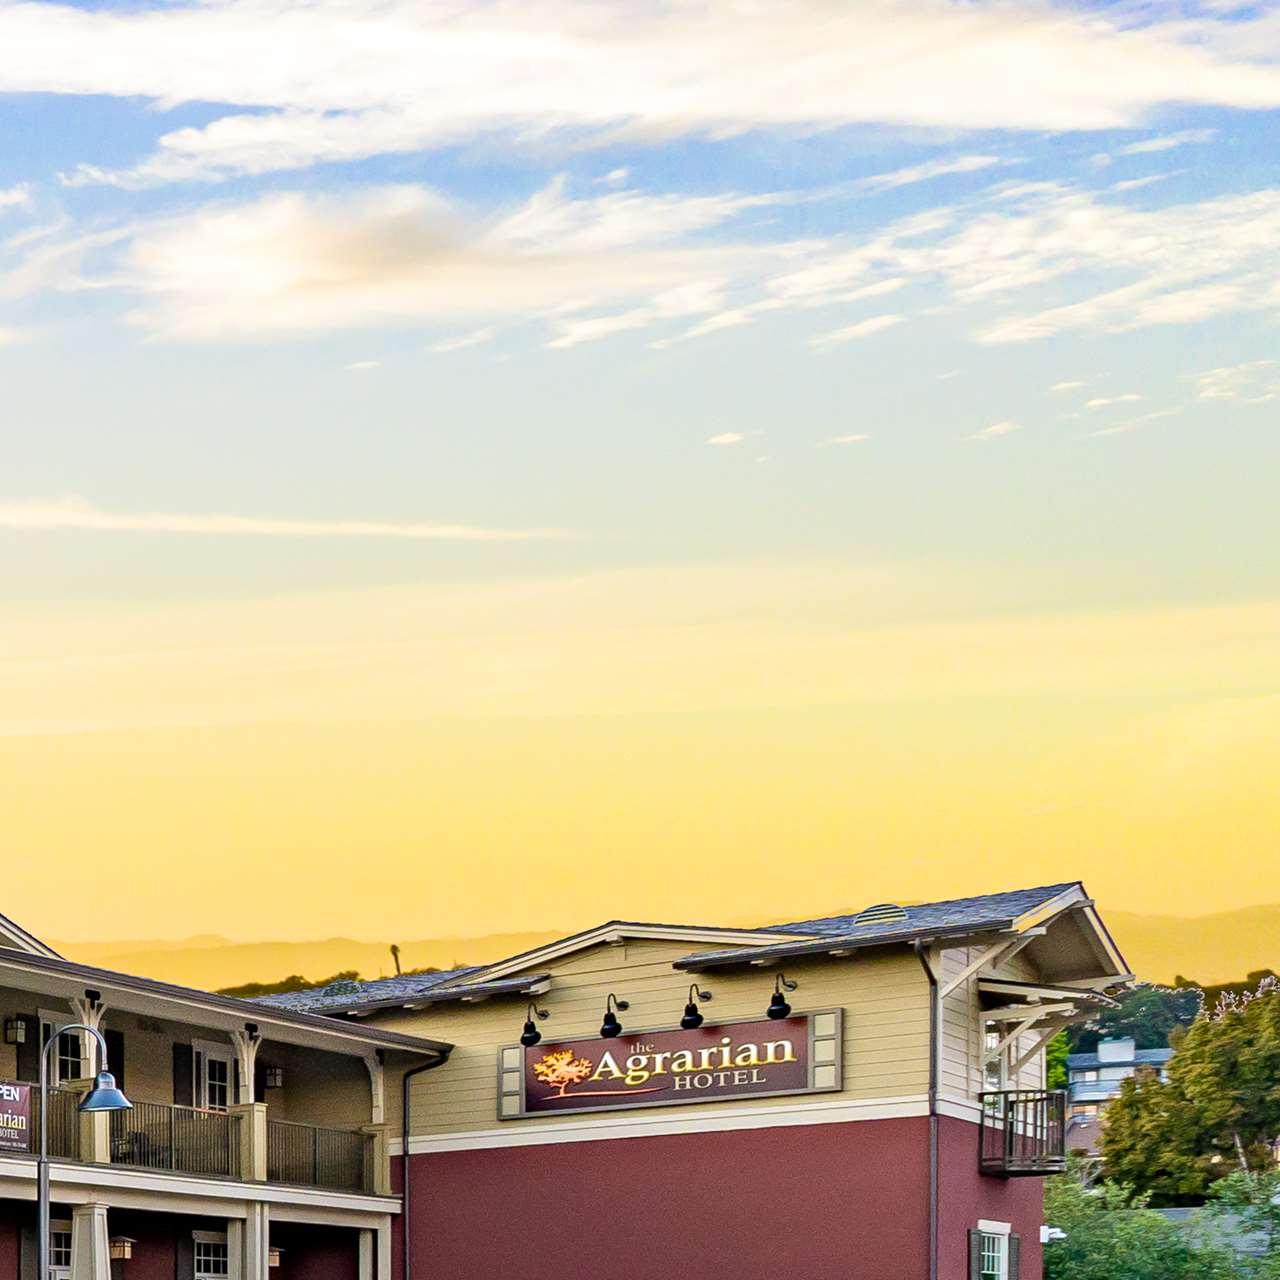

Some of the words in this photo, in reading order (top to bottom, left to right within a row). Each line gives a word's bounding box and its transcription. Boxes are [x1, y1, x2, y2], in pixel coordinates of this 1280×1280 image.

[629, 1041, 654, 1054] the
[587, 1036, 798, 1087] Agrarian
[672, 1068, 767, 1092] HOTEL
